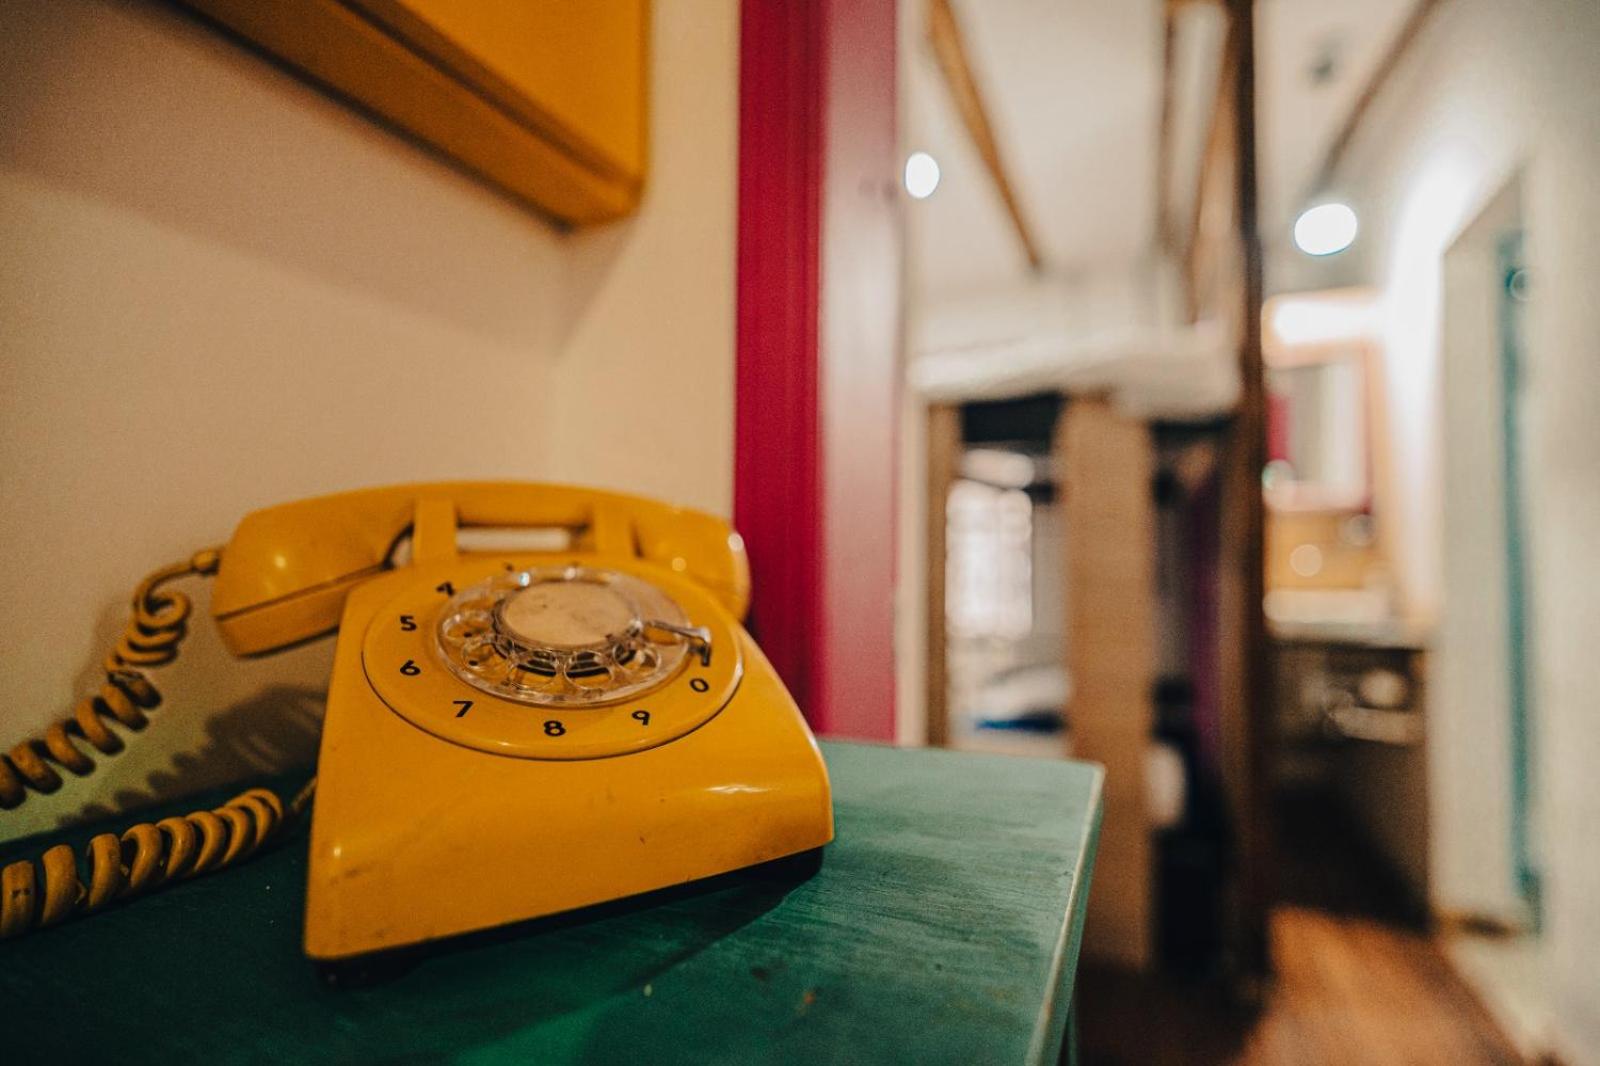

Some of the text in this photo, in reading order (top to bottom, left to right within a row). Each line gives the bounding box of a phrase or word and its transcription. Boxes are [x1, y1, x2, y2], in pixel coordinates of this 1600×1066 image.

[400, 615, 418, 632] 5
[399, 659, 421, 676] 6
[453, 700, 473, 718] 7
[631, 710, 650, 726] 9
[543, 720, 566, 737] 8
